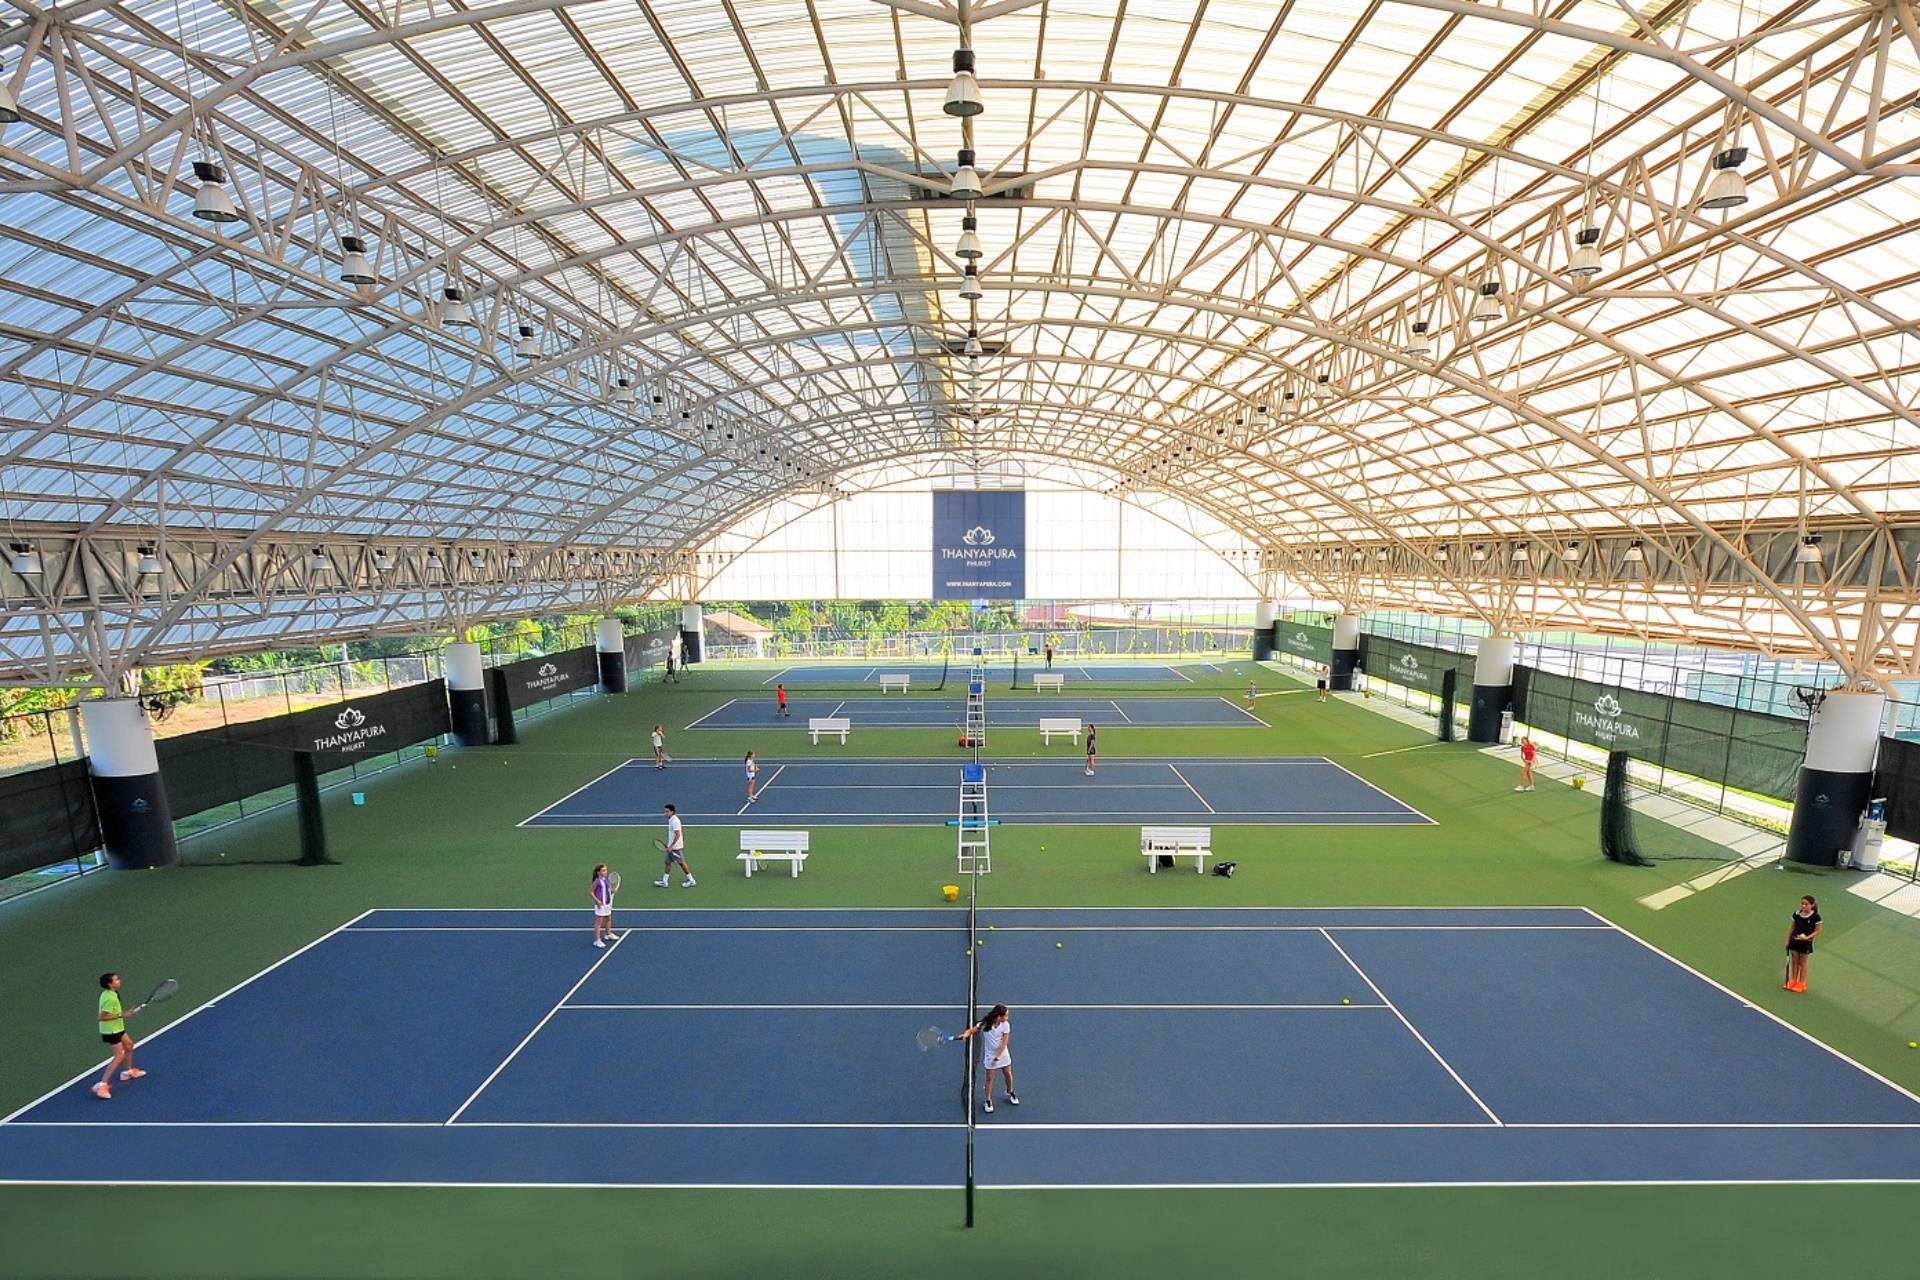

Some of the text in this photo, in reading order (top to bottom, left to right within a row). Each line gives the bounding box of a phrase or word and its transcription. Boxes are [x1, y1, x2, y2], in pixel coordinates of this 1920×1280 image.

[941, 548, 1017, 559] THANYAPURA
[313, 724, 386, 751] THANYAPURA
[1575, 712, 1639, 739] THANYAPURA
